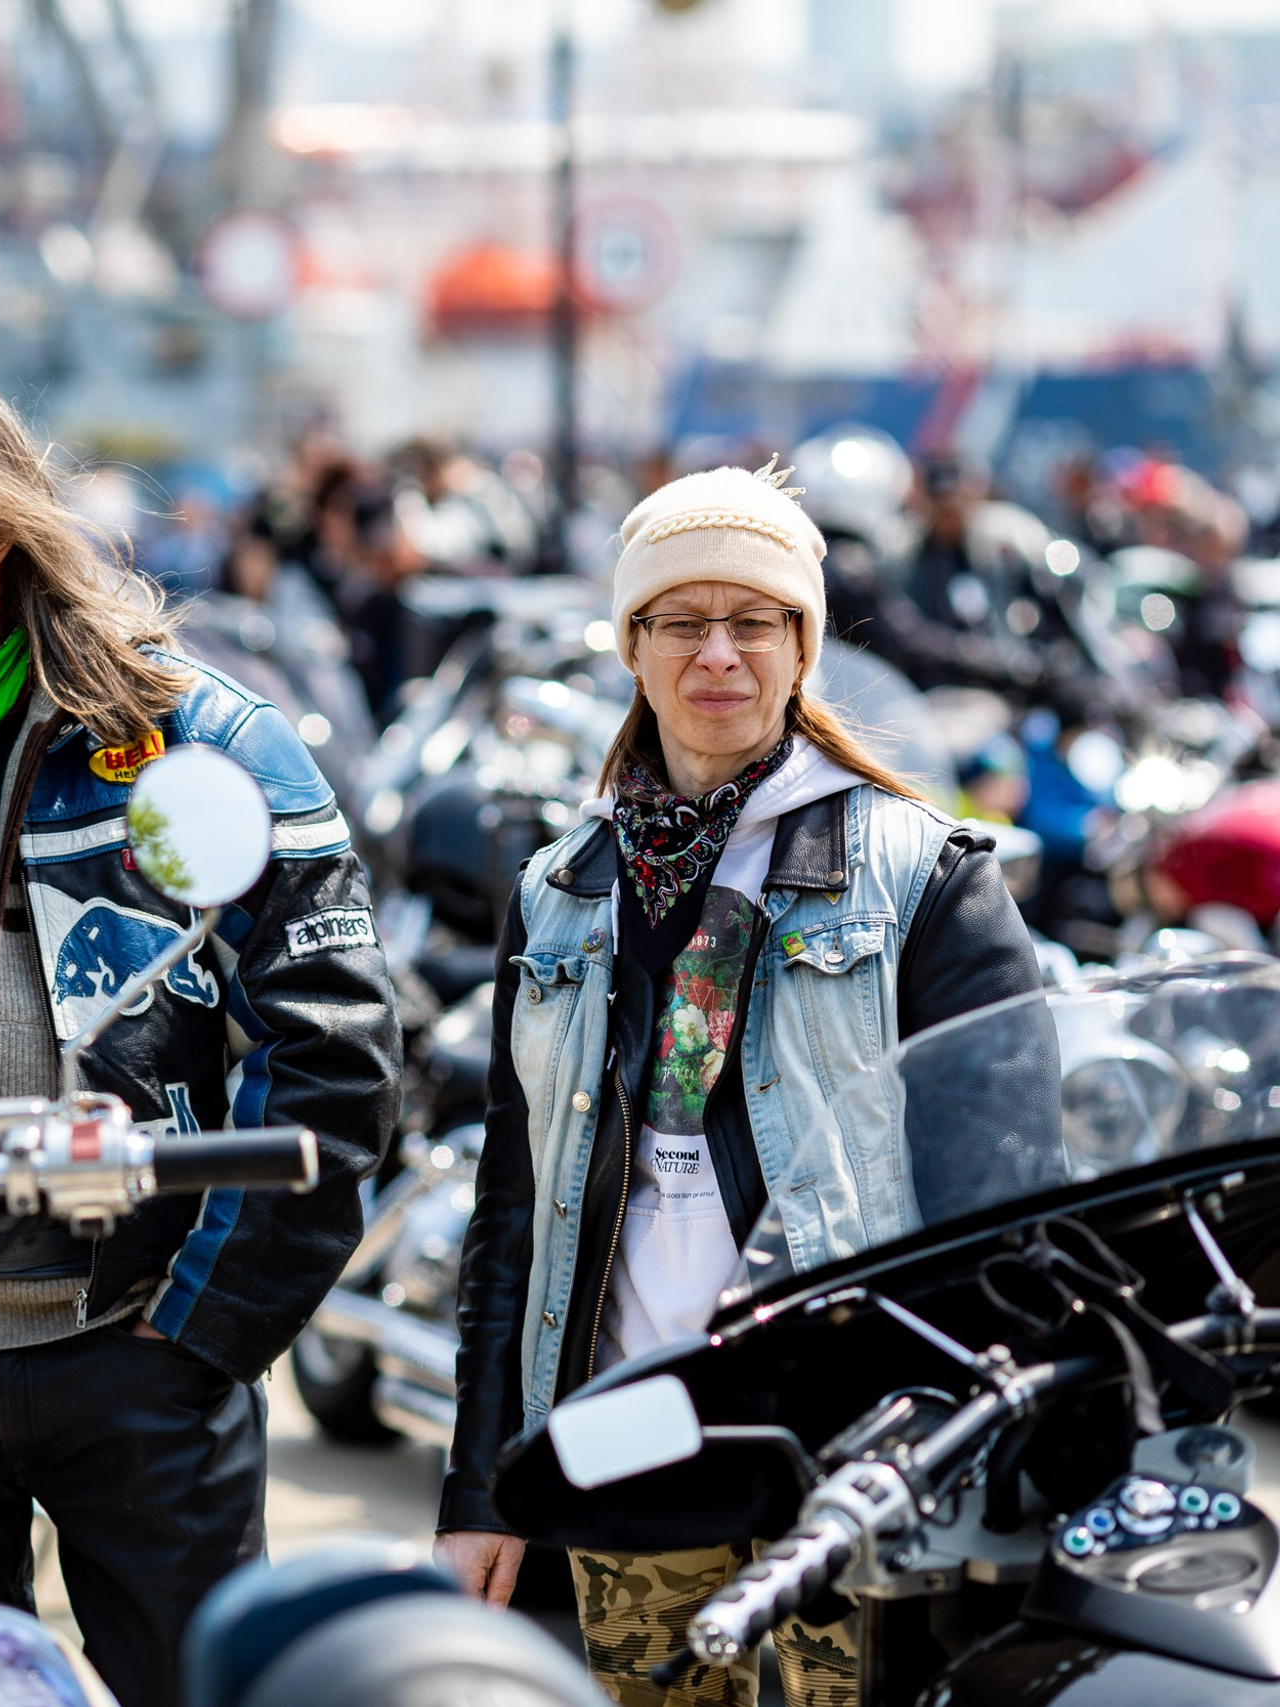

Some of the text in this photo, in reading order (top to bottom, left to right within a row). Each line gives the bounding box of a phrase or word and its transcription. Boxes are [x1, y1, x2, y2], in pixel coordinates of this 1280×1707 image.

[104, 732, 166, 770] BELL
[655, 1146, 700, 1165] Second
[650, 1157, 700, 1180] NATURE
